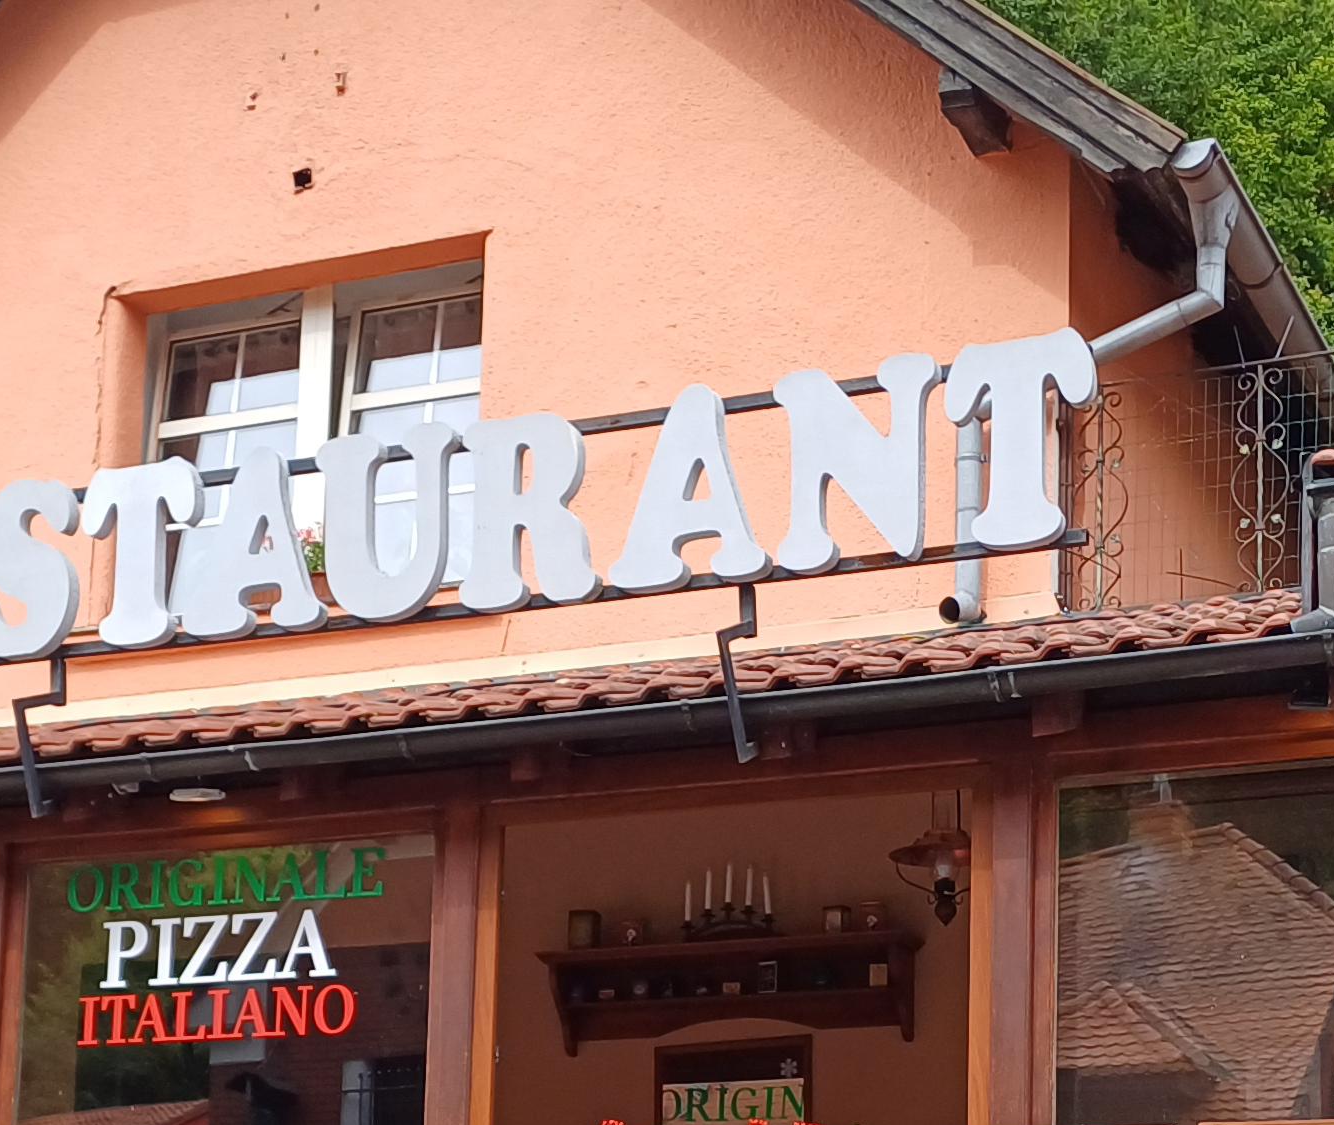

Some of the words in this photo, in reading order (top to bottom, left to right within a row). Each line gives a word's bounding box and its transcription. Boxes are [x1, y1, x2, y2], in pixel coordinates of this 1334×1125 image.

[67, 847, 388, 913] ORIGINALE
[99, 908, 338, 990] PIZZA
[76, 984, 357, 1047] ITALIANO
